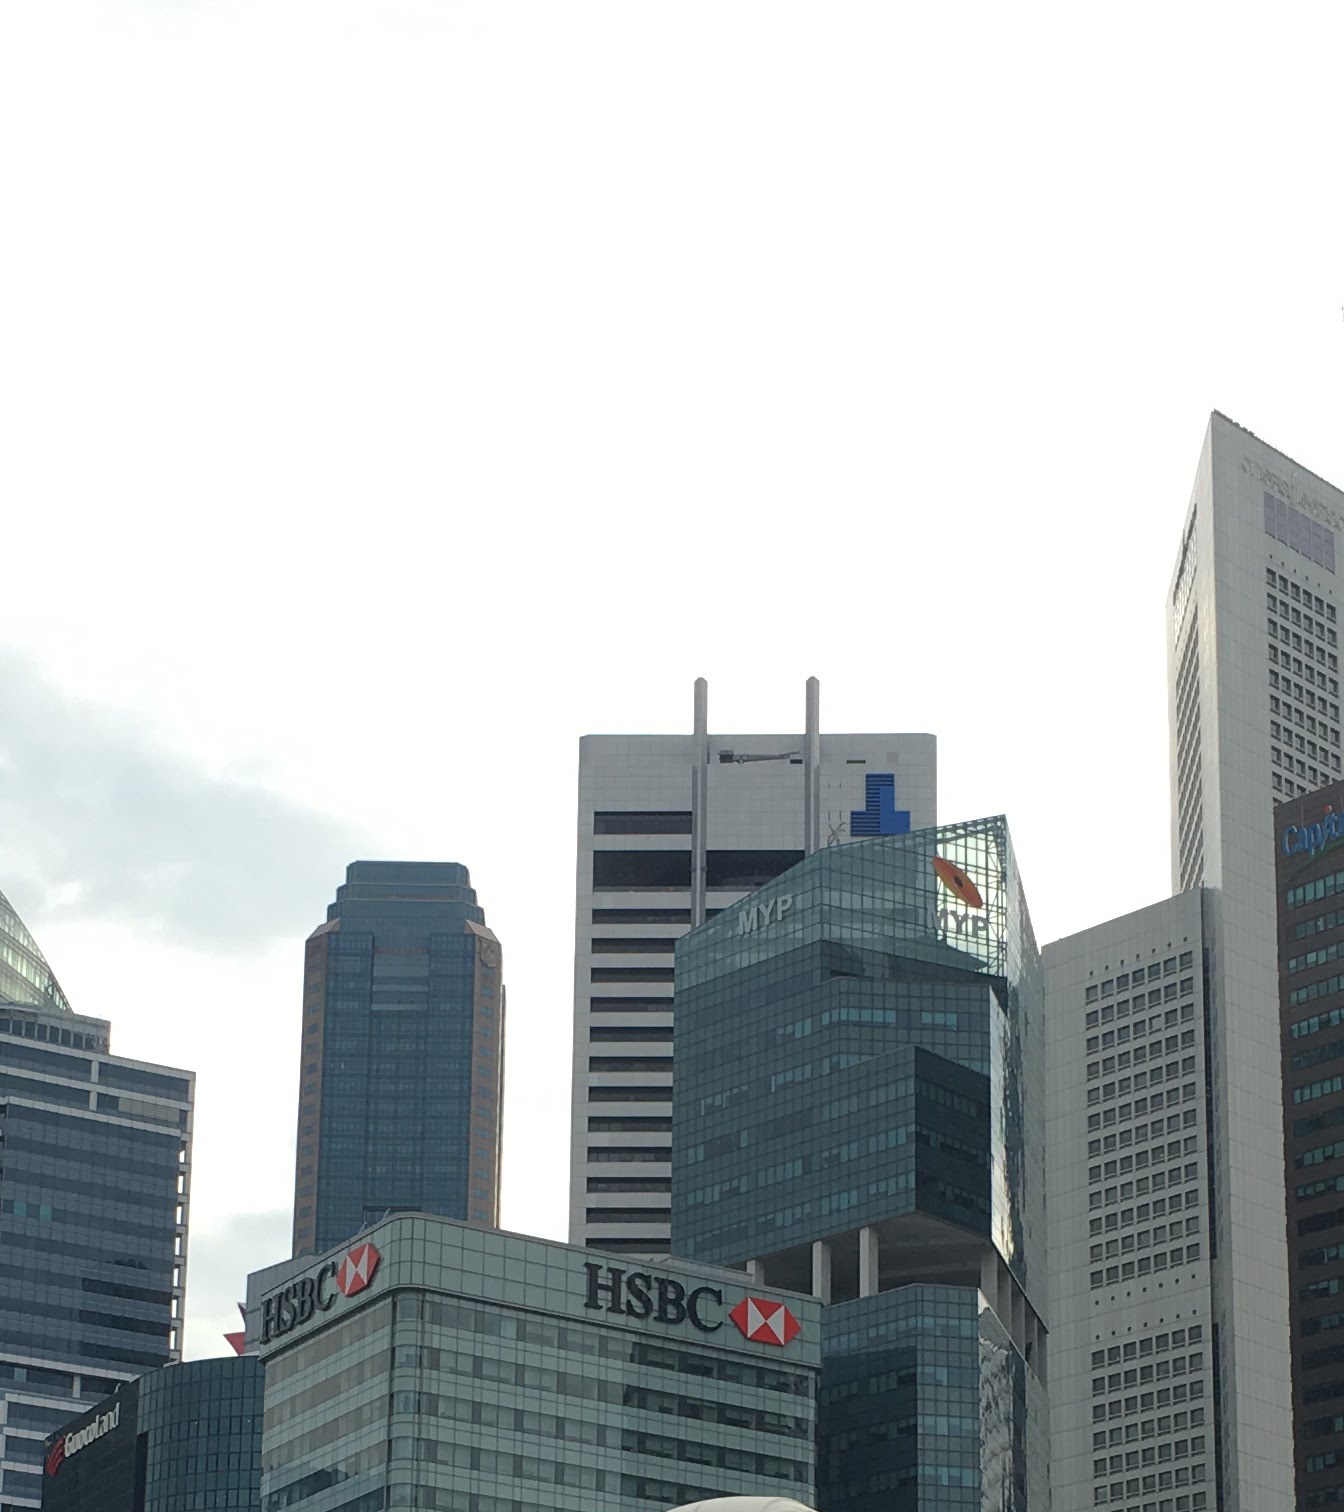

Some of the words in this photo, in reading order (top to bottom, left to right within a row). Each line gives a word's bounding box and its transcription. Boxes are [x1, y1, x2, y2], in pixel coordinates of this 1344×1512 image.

[738, 894, 793, 936] MYP
[925, 904, 989, 939] MYP
[259, 1261, 337, 1345] HSBC
[583, 1261, 724, 1333] HSBC
